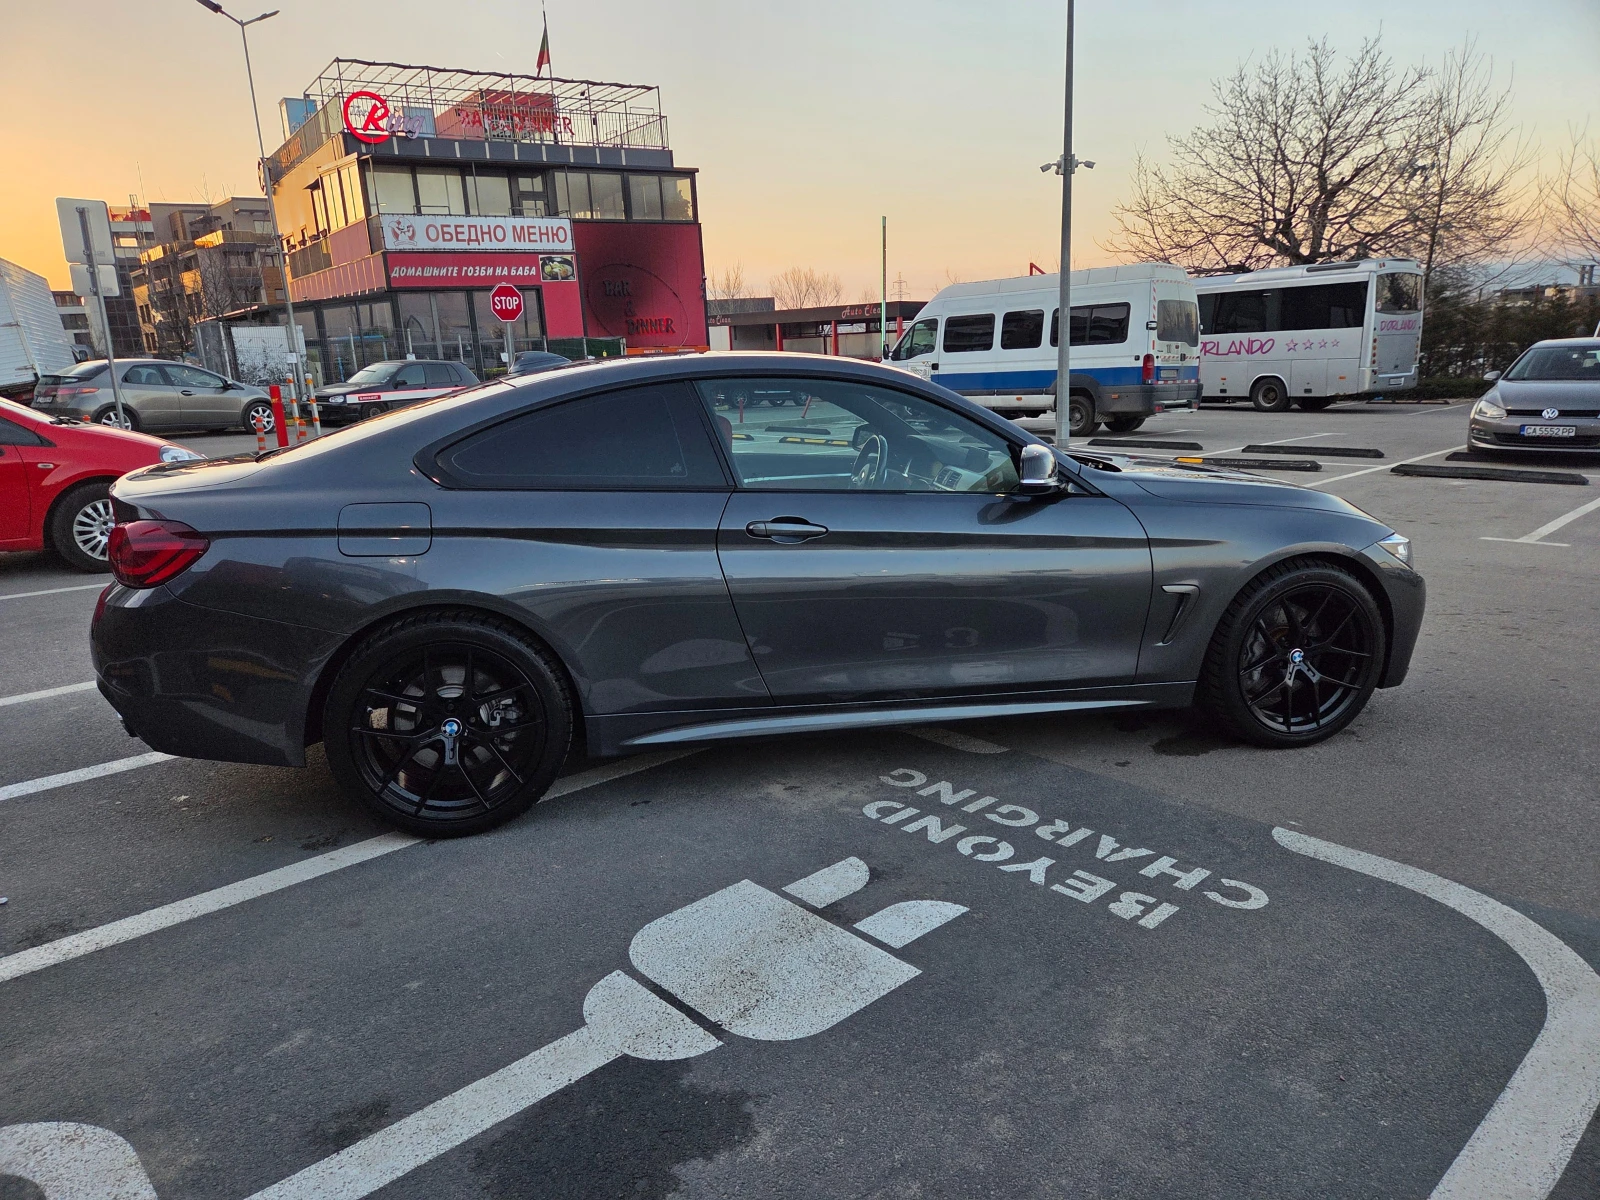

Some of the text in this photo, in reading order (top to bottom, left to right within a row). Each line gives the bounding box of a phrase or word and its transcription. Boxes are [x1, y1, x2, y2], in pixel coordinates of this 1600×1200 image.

[425, 224, 568, 246] ОБЕДНО МЕНЮ
[391, 266, 536, 279] ДОМАШНИТЕ ГОЗБИ НА БАБА
[603, 280, 632, 297] BAR
[494, 296, 520, 310] STOP
[841, 304, 882, 319] Auto Clea
[626, 317, 676, 336] DINNER
[1538, 427, 1560, 435] 5552
[878, 768, 1270, 910] CHARGING
[862, 800, 1180, 929] BEYOND
